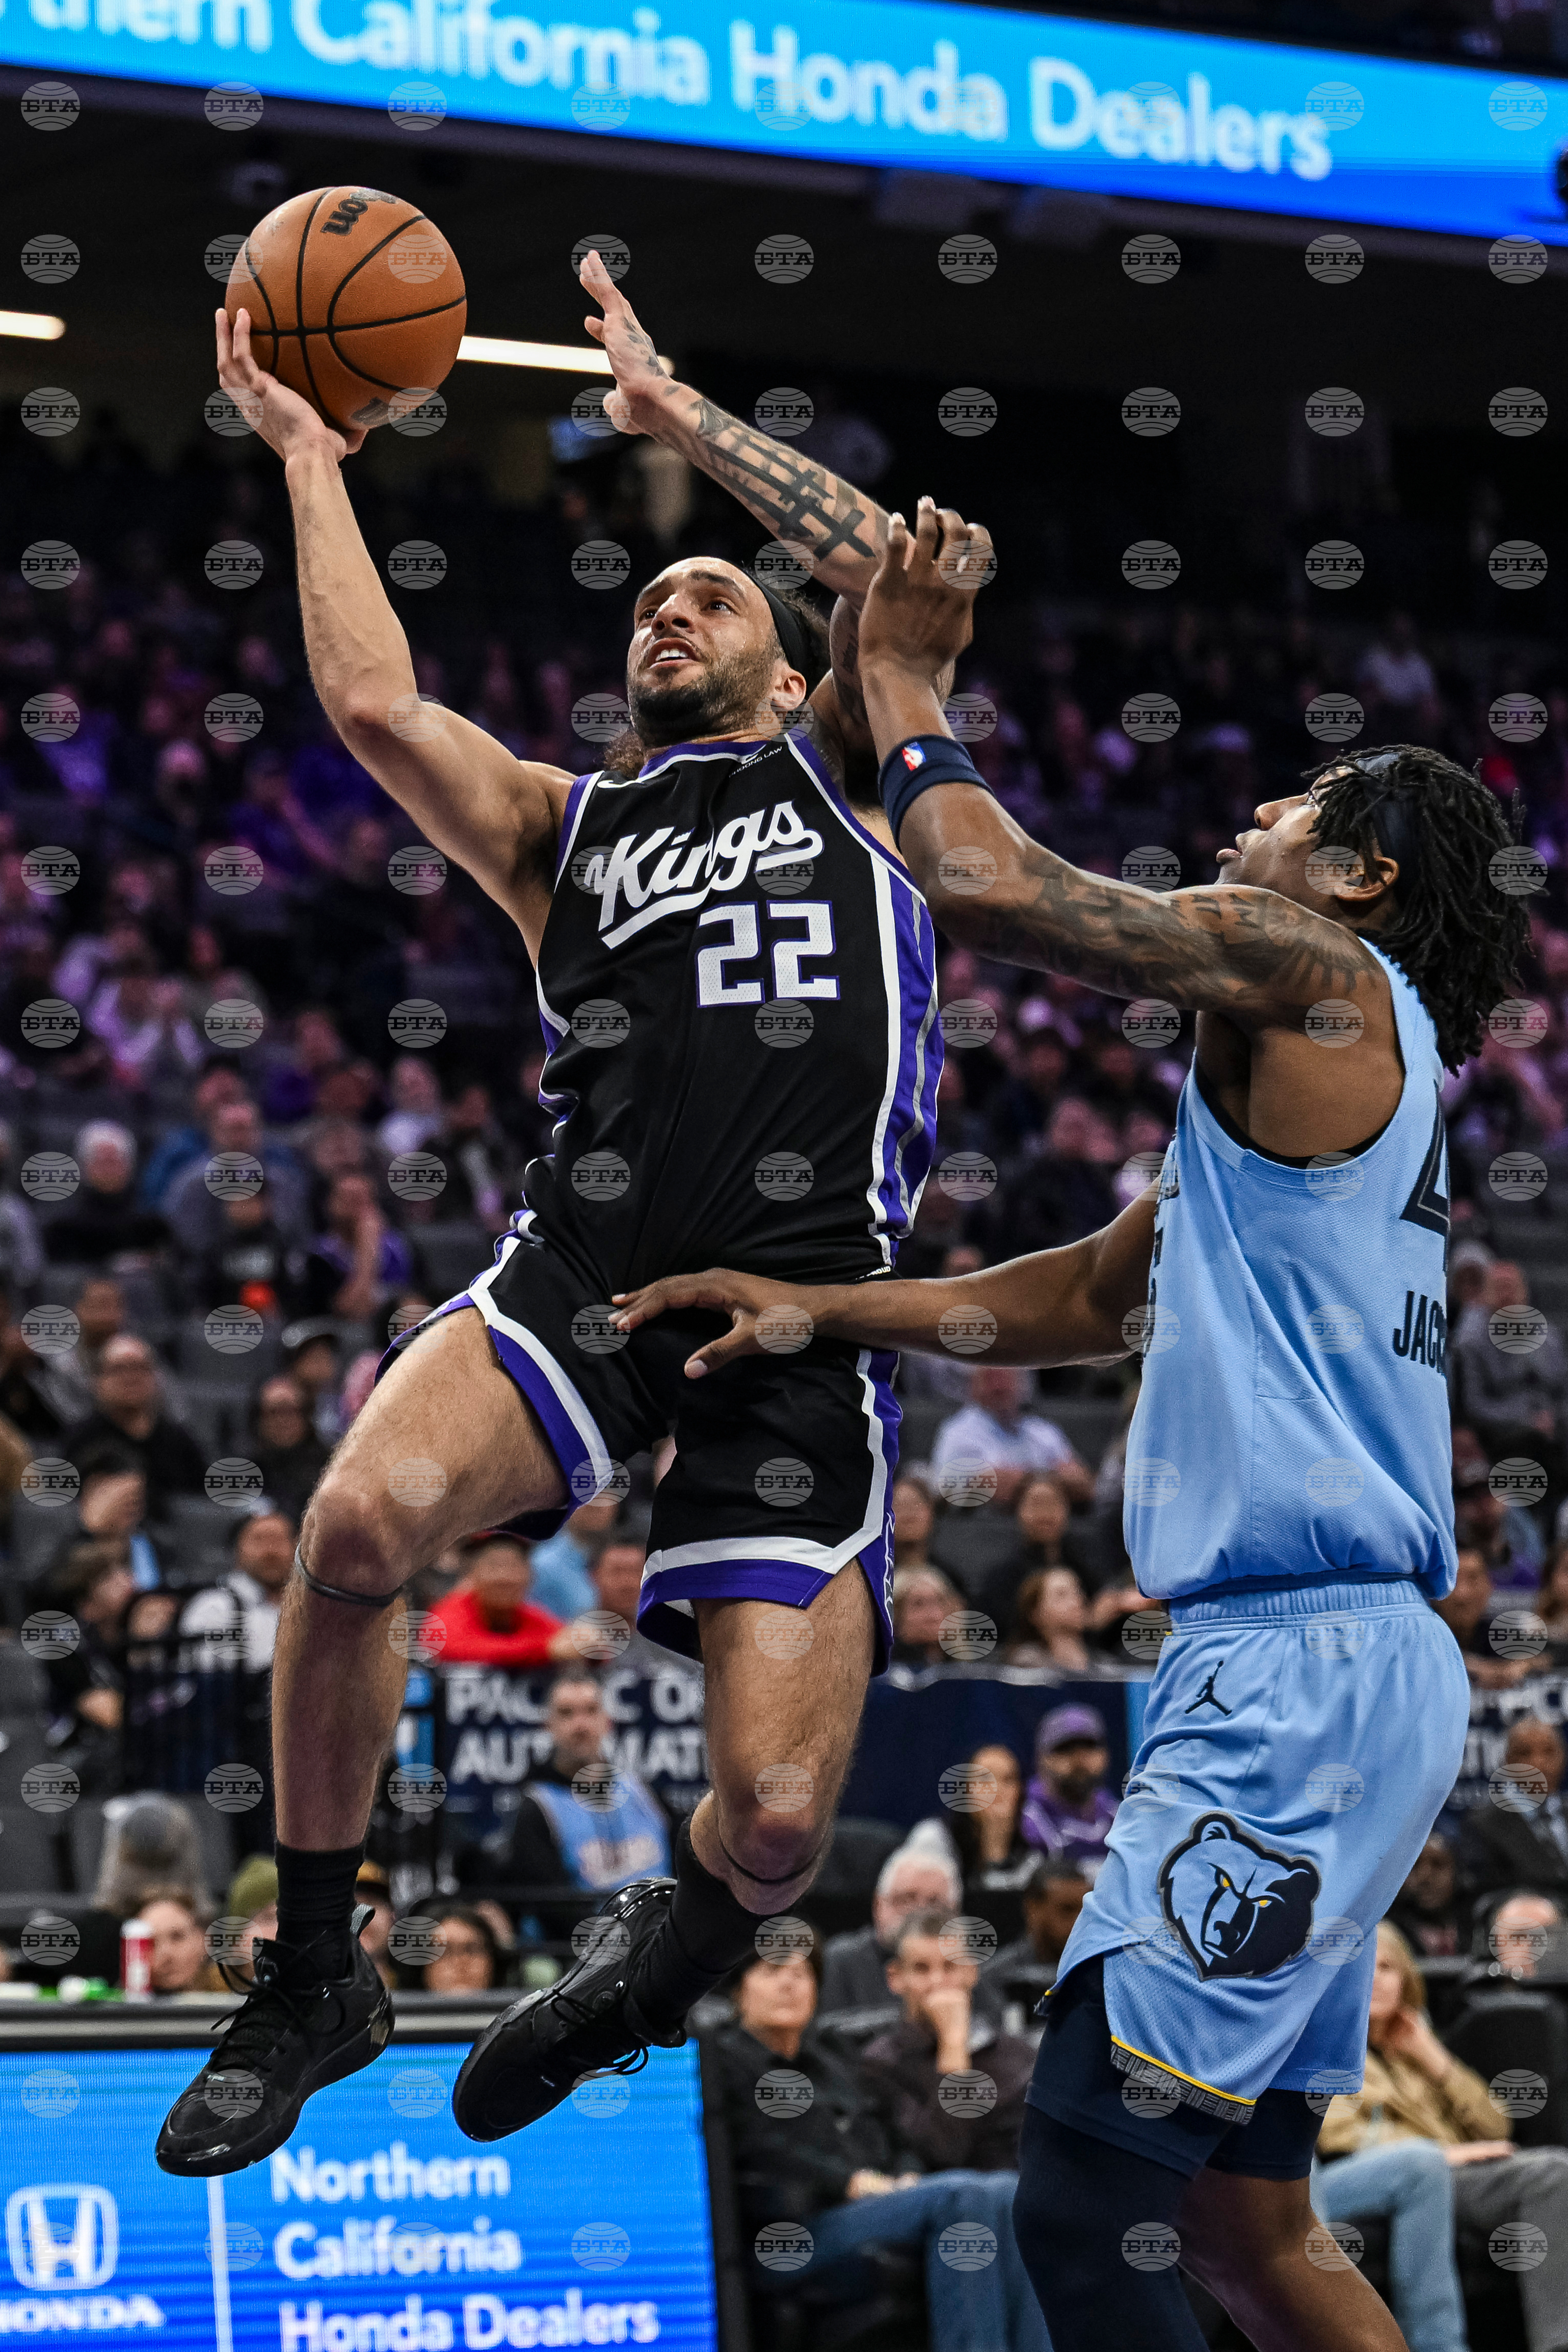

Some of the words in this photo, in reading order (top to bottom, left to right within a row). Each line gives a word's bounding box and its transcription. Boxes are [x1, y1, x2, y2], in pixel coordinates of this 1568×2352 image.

[289, 0, 712, 105] California
[729, 19, 1008, 142] Honda
[1028, 55, 1333, 181] Dealers
[764, 746, 783, 758] LAW
[583, 800, 825, 949] Kings
[696, 900, 840, 1008] 22
[866, 1265, 891, 1277] ROUD
[270, 2142, 511, 2203] Northern
[273, 2215, 522, 2280] California
[279, 2292, 455, 2352] Honda
[462, 2287, 661, 2350] Dealers
